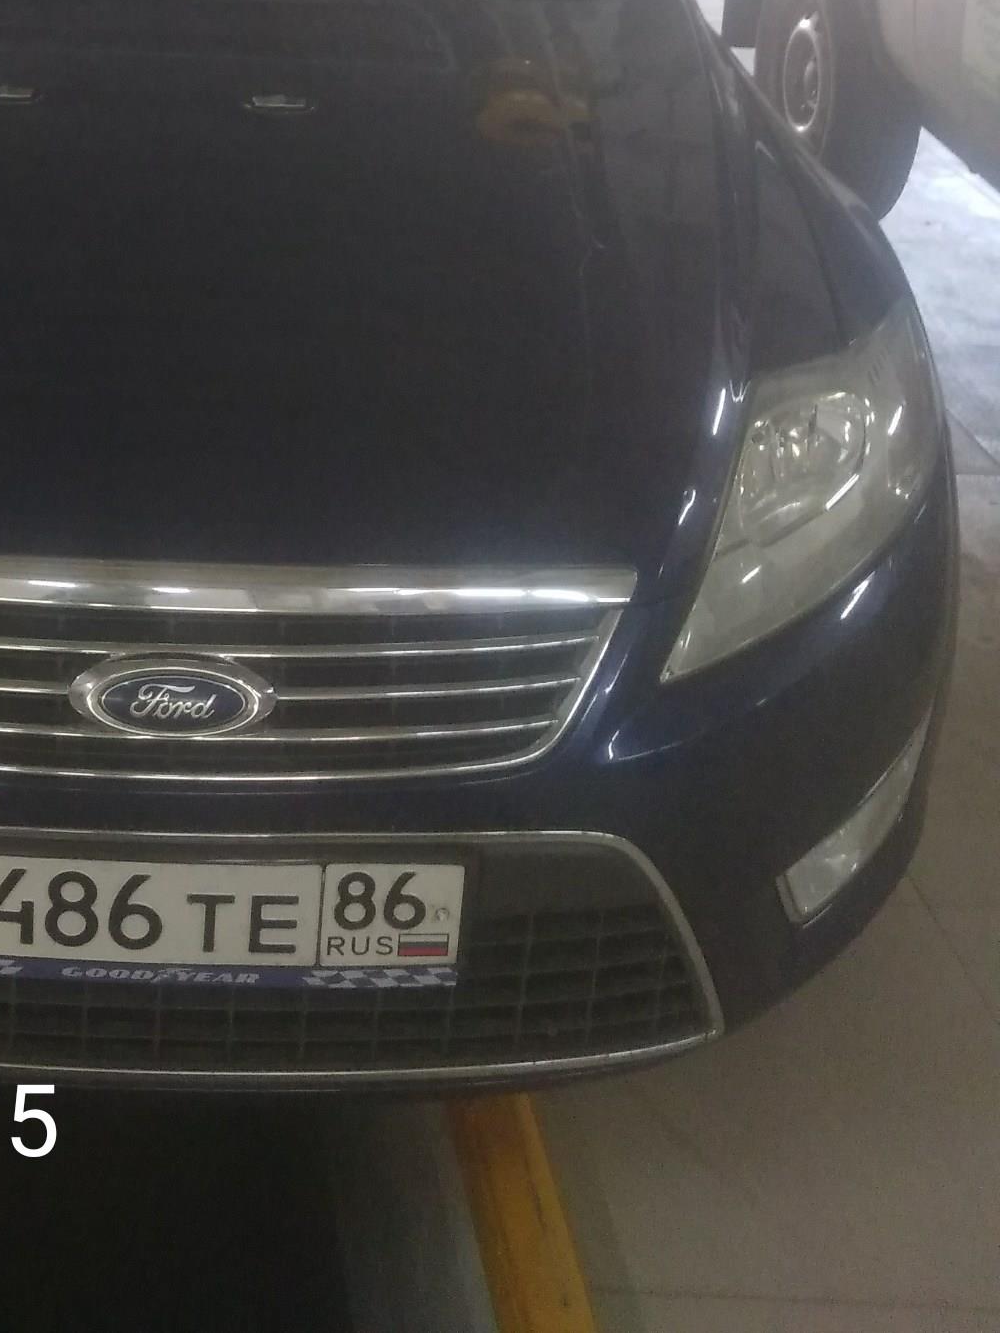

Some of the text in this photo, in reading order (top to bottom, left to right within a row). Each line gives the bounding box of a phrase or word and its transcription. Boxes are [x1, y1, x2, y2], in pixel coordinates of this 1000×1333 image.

[129, 683, 217, 718] Ford
[333, 871, 427, 932] 86
[326, 935, 394, 957] RUS
